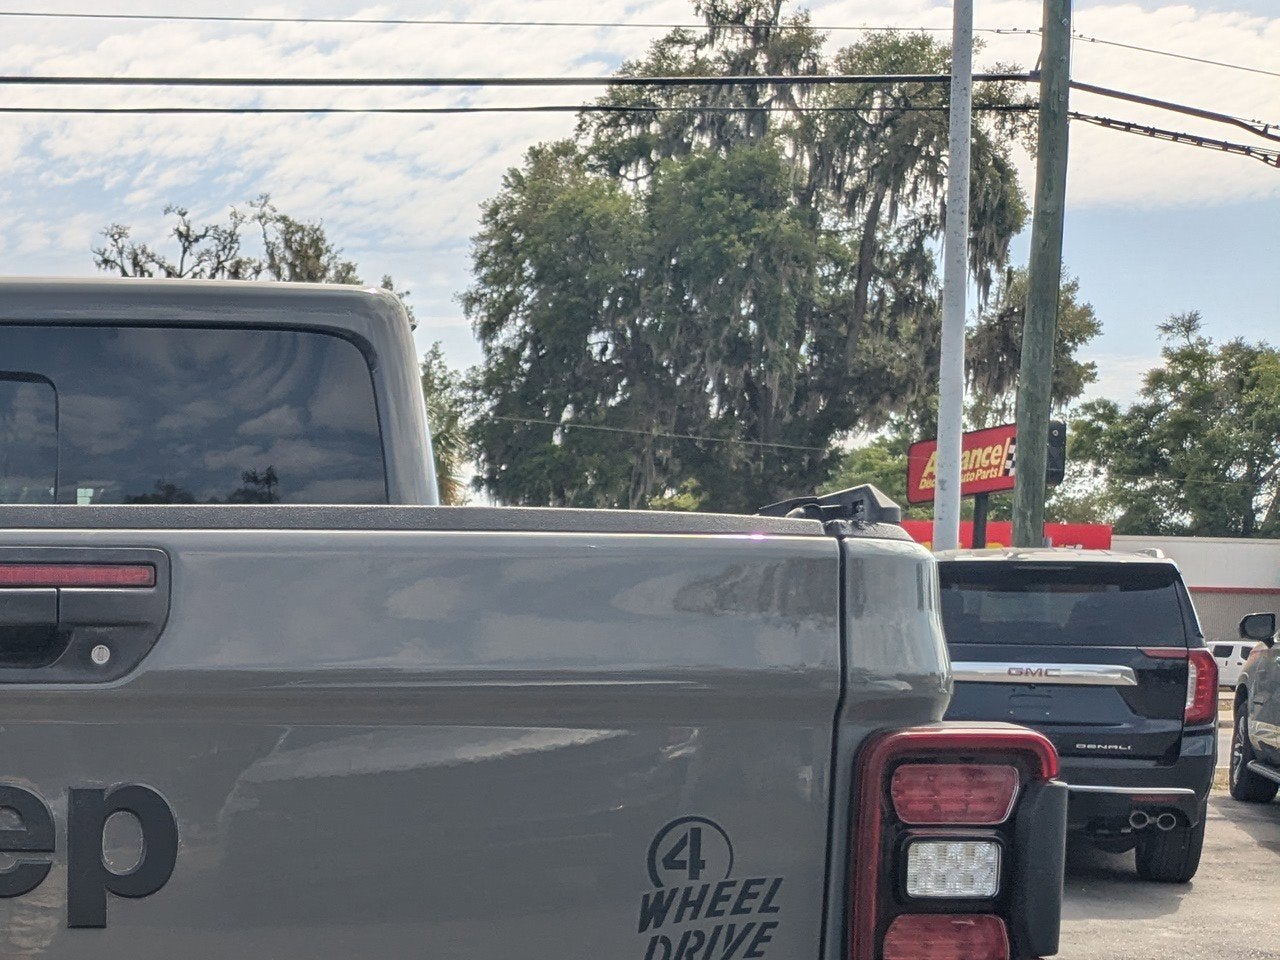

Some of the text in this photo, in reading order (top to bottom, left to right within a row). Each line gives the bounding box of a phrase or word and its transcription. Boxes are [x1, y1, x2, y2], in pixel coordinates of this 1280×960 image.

[922, 444, 1002, 478] Aance
[975, 466, 998, 481] Parts
[1007, 667, 1061, 677] GMC
[1075, 743, 1132, 751] DENALI
[662, 827, 705, 880] 4
[637, 877, 783, 934] WHEEL
